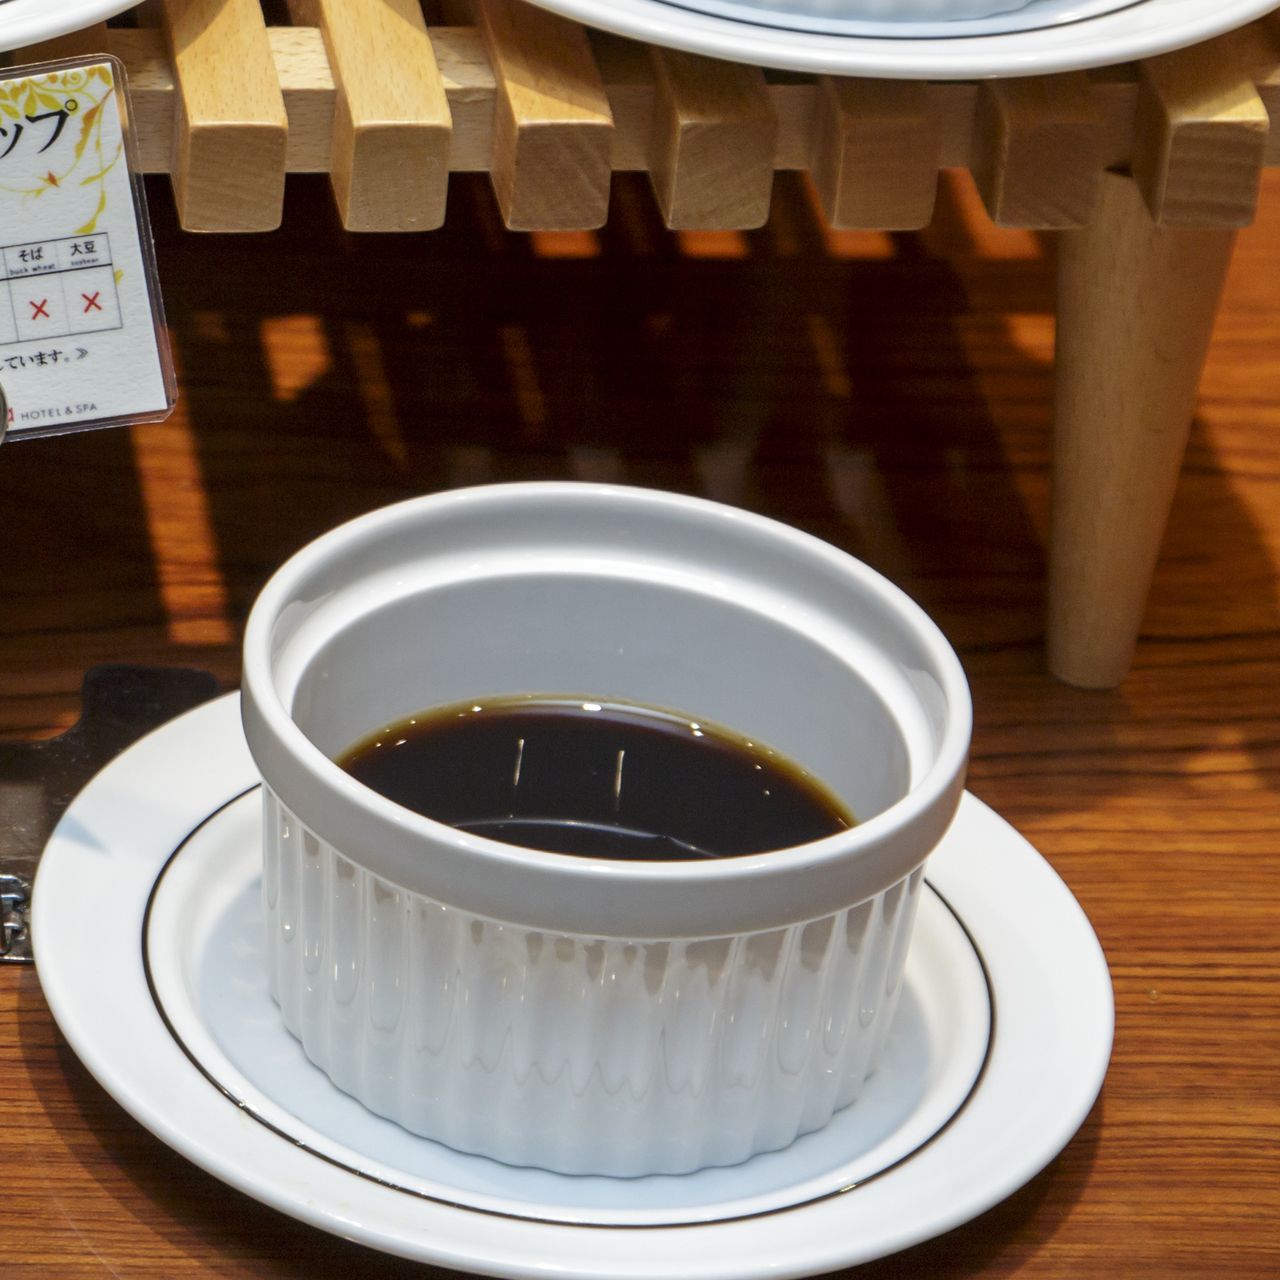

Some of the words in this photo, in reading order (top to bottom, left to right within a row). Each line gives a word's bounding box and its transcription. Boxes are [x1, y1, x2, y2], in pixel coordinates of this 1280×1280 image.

[18, 246, 44, 262] そば
[70, 240, 97, 256] 大豆
[21, 405, 62, 421] HOTEL
[65, 405, 73, 415] &
[76, 402, 98, 414] SPA
